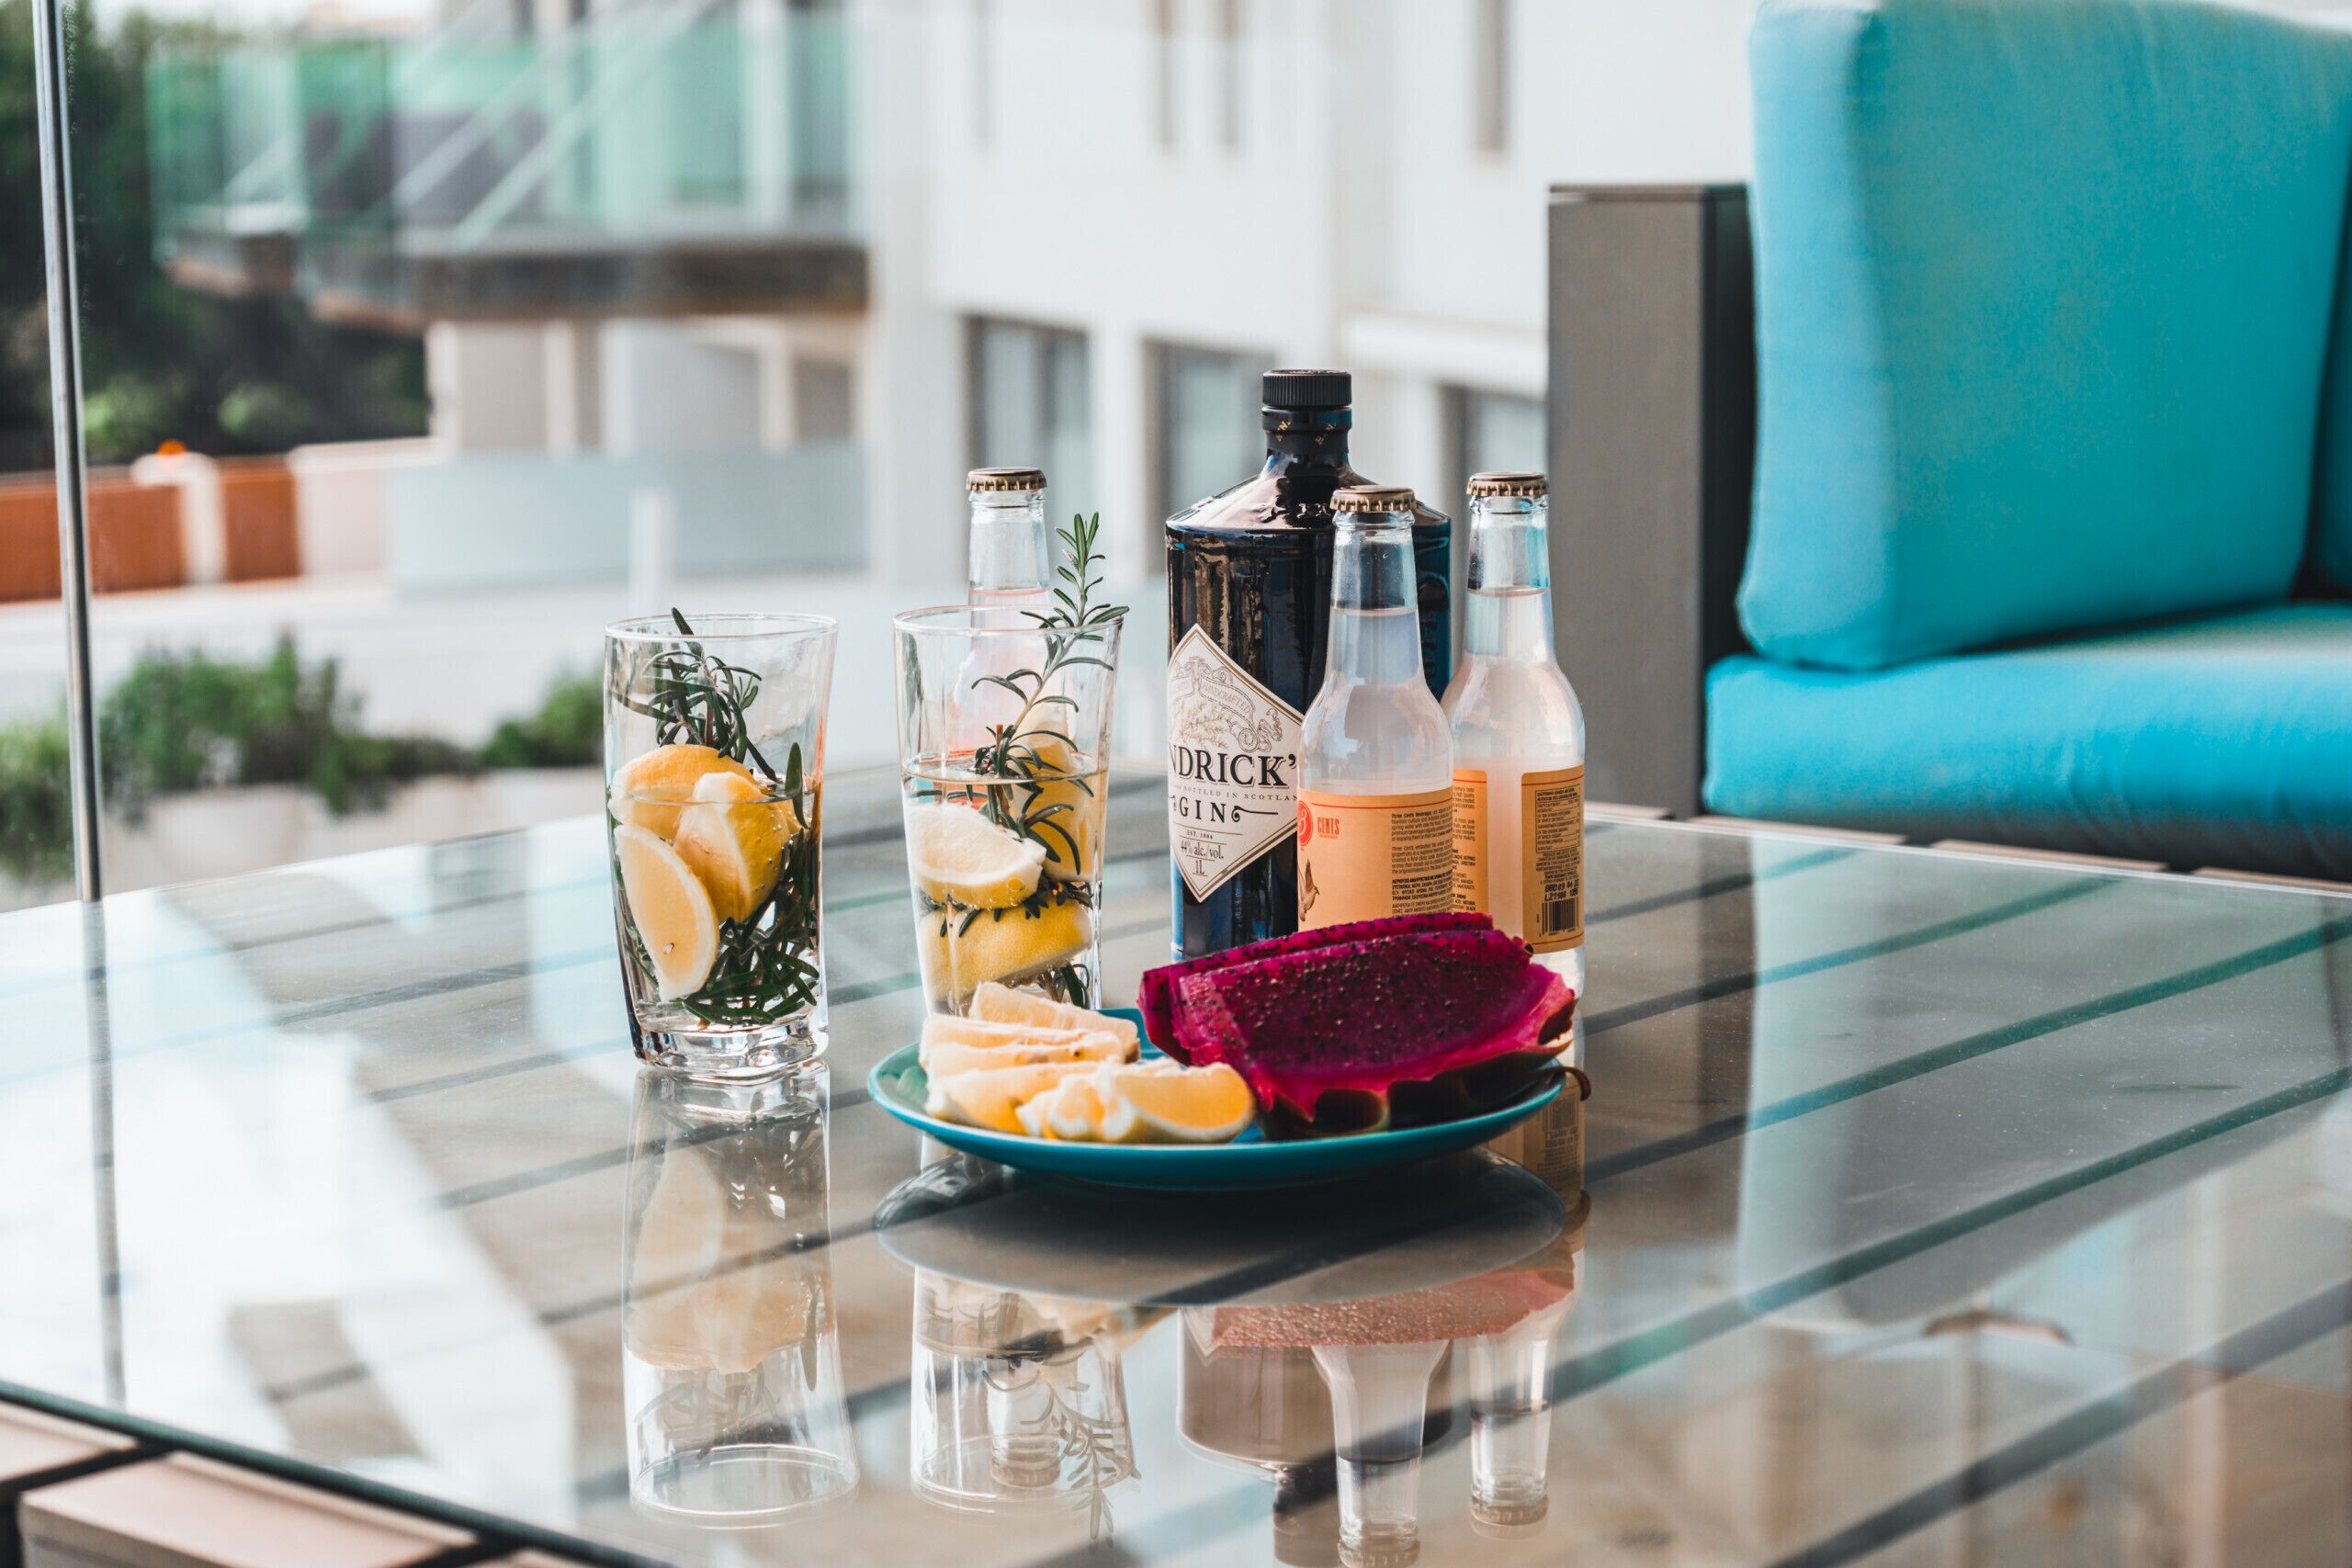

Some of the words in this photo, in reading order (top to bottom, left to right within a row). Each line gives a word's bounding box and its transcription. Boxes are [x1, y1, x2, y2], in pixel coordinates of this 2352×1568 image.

[1183, 785, 1221, 796] BOTTLED
[1179, 795, 1227, 824] GIN
[1317, 817, 1340, 835] CENTS
[1195, 860, 1205, 874] 1L
